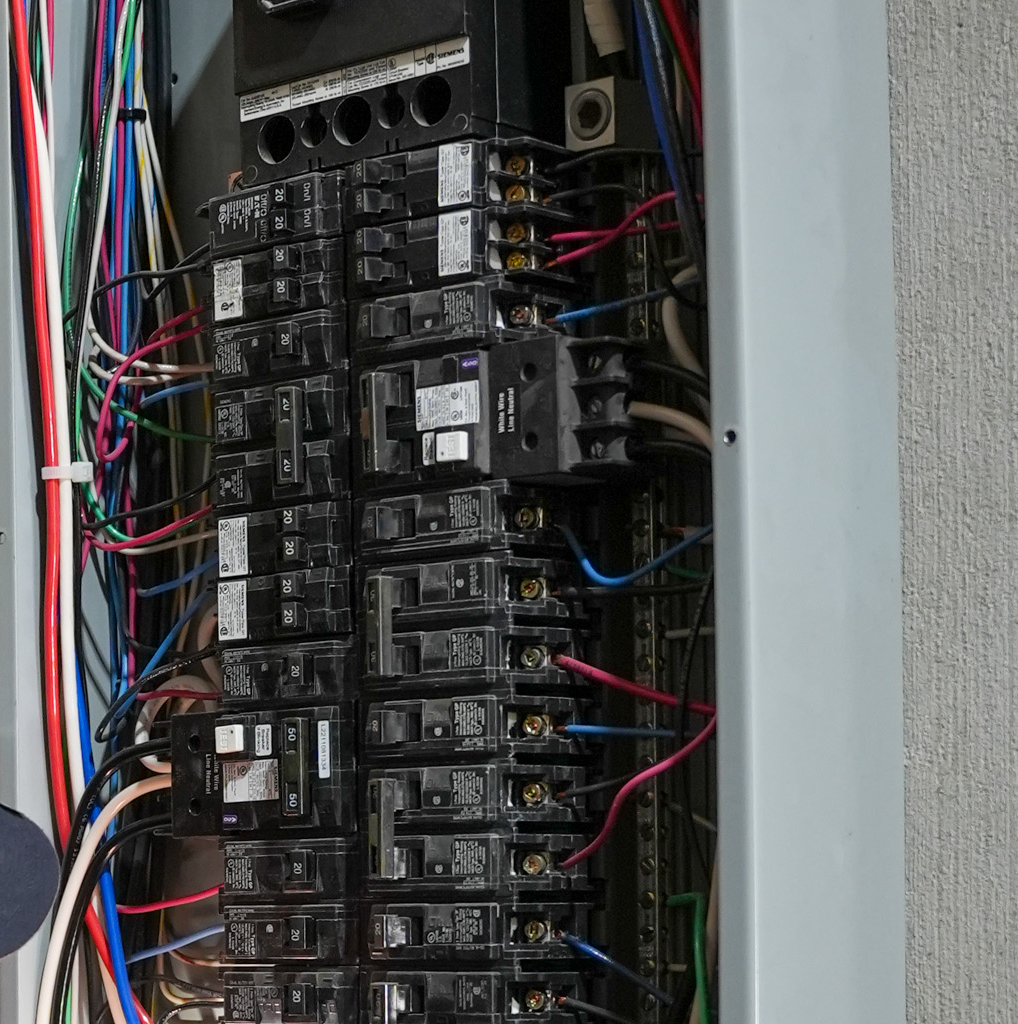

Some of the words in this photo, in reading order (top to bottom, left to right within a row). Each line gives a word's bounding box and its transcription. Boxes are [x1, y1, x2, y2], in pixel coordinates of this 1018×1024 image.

[437, 47, 465, 61] SIEMENS
[355, 163, 362, 178] 20
[274, 188, 284, 202] 20
[356, 193, 362, 208] 20
[274, 215, 284, 229] 20
[356, 230, 362, 245] 20
[275, 248, 284, 262] 20
[357, 260, 363, 275] 20
[277, 280, 285, 294] 20
[363, 314, 369, 327] 20
[281, 333, 290, 346] 20
[507, 387, 515, 415] Neutral
[284, 510, 293, 524] 20
[286, 541, 295, 556] 20
[283, 579, 292, 593] 20
[284, 609, 294, 624] 20
[291, 665, 300, 678] 20
[371, 720, 378, 733] 20
[219, 729, 228, 751] TEST
[288, 727, 297, 742] 50
[205, 769, 213, 795] Neutral
[288, 793, 298, 808] 50
[293, 862, 302, 875] 20
[291, 929, 300, 942] 20
[374, 922, 381, 936] 20
[292, 989, 302, 1003] 20
